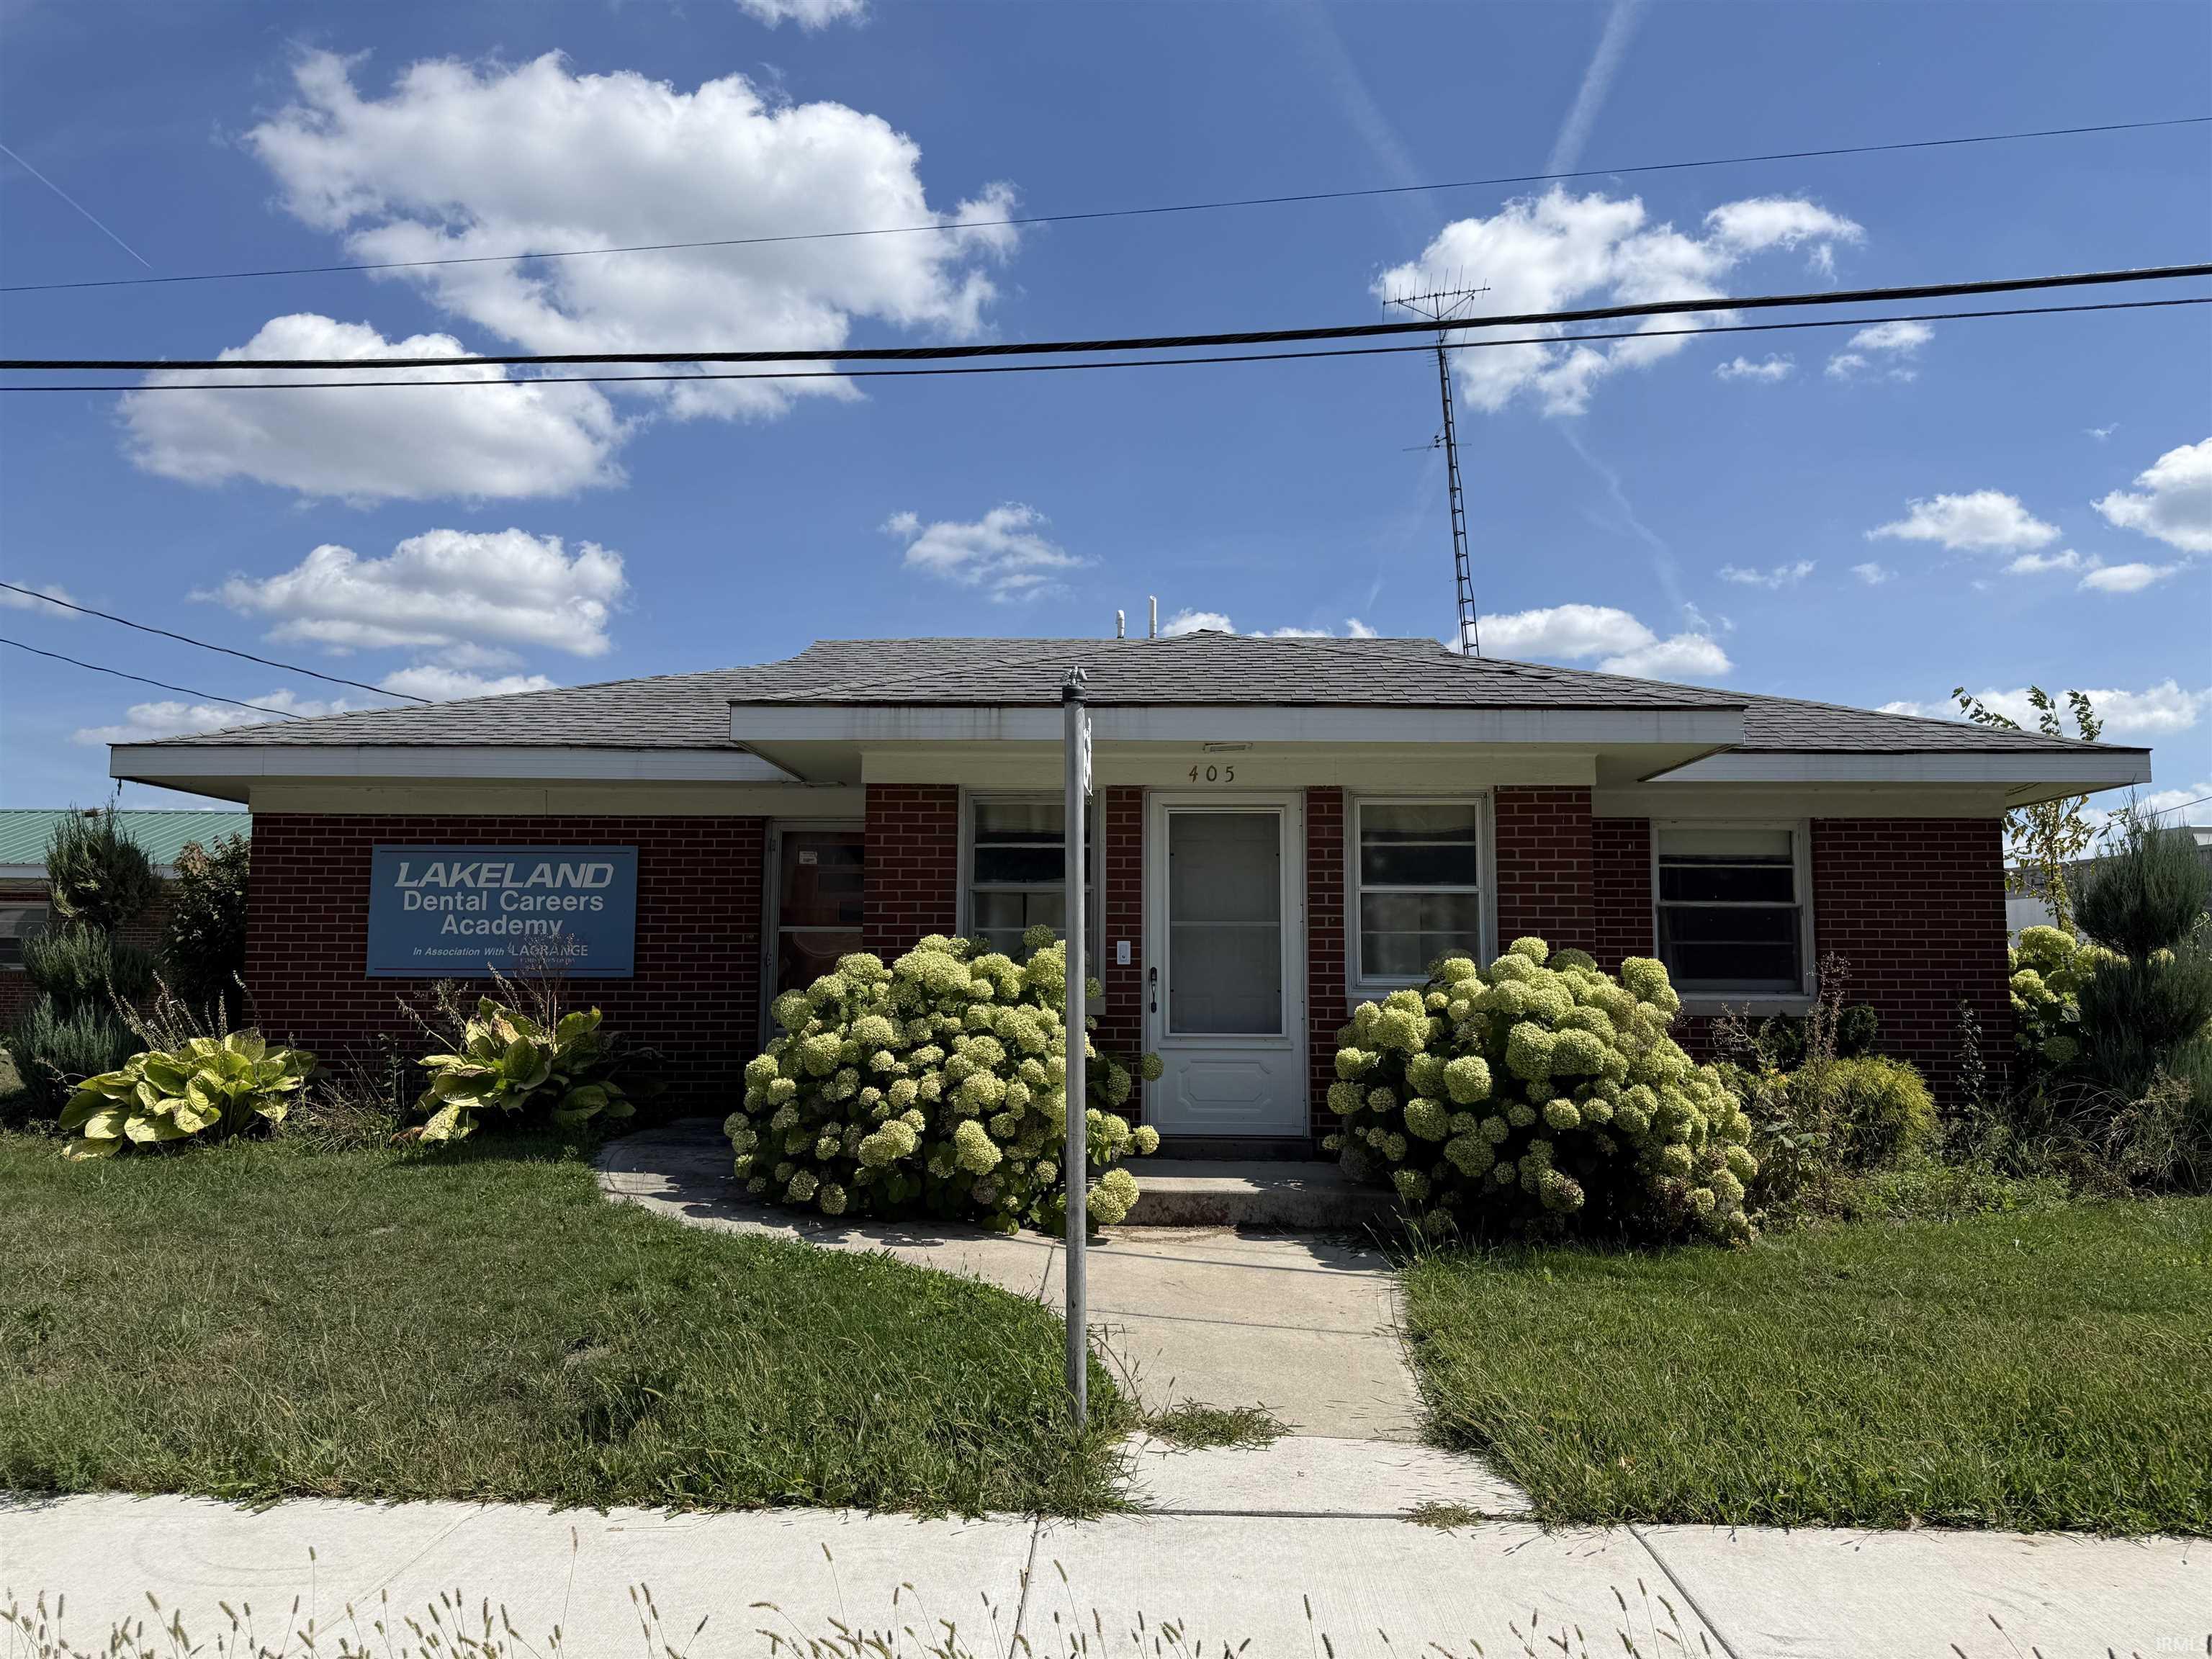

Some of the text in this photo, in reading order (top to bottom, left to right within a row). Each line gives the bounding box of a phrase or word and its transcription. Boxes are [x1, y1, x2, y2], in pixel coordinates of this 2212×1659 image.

[1189, 765, 1234, 783] 405
[395, 863, 614, 888] LAKELAND
[403, 890, 603, 911] Dental Careers
[440, 914, 564, 938] Academy
[413, 945, 588, 956] In Association With LAGRANGE
